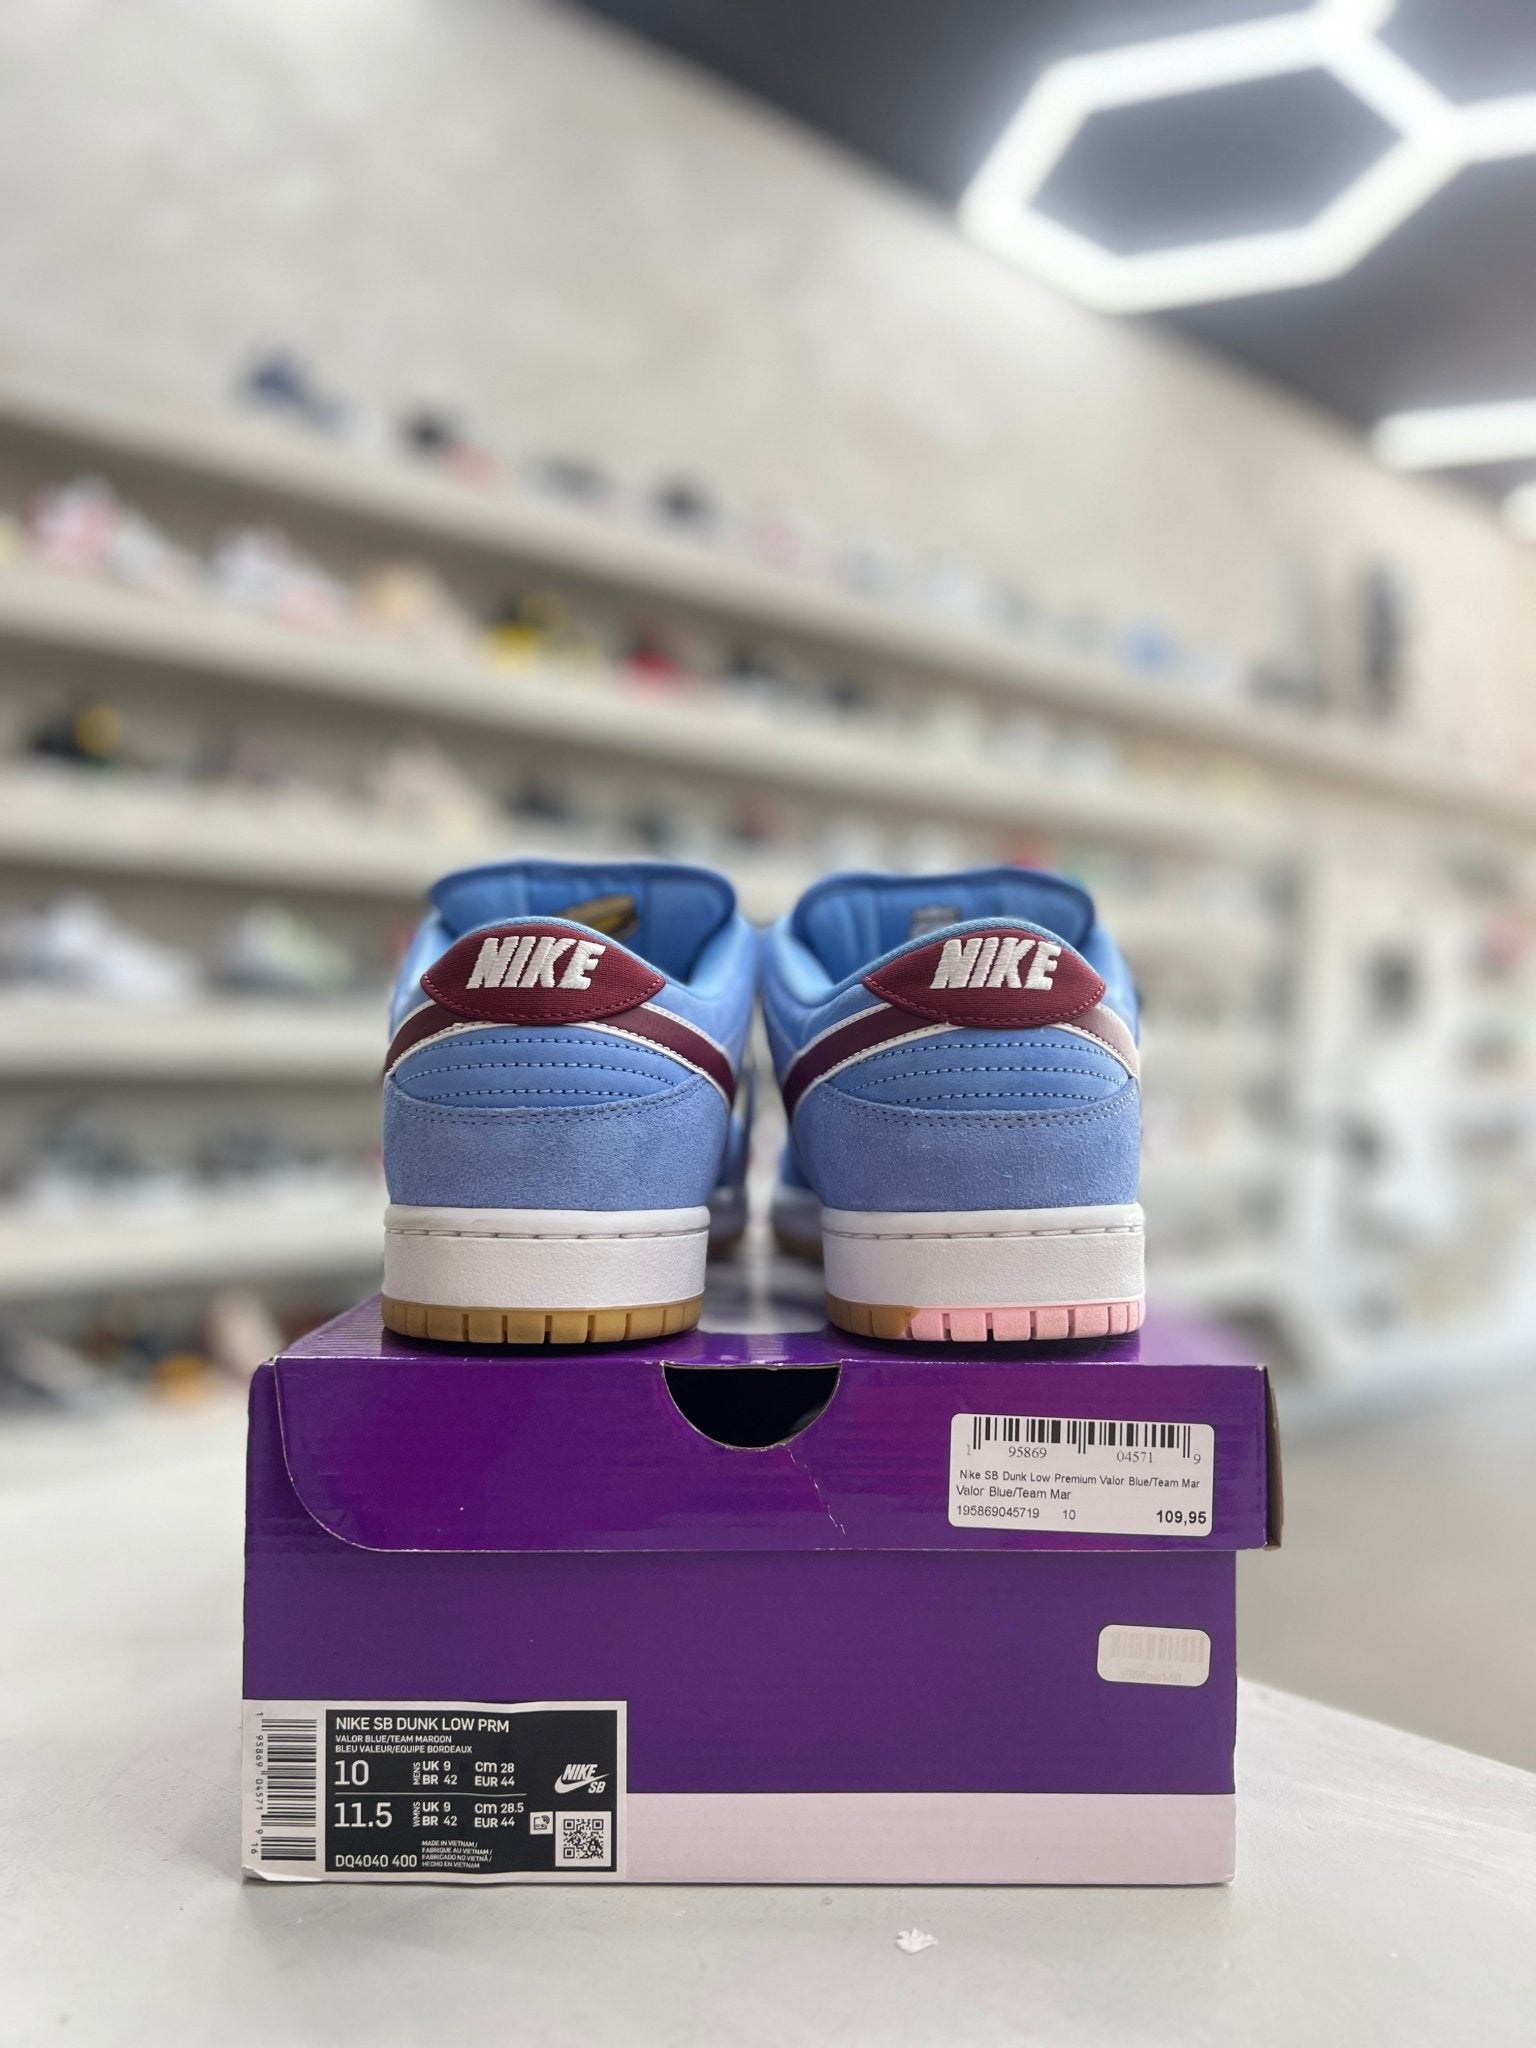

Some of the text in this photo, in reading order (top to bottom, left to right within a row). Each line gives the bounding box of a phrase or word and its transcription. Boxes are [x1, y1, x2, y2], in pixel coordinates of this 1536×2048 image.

[466, 936, 606, 990] NIKE
[930, 937, 1061, 990] NIKE
[966, 1444, 1201, 1464] 1 95869 04571 9
[959, 1469, 1200, 1488] Nke SB Dunk Low Premium Valor Blue/Team Mar
[956, 1484, 1071, 1500] Valor Blue/Team Mar
[957, 1504, 1076, 1520] 195869045719 10
[1156, 1509, 1207, 1526] 109,95
[336, 1717, 510, 1733] NIKE SB DUNK LOW PRM
[335, 1734, 452, 1744] VALOR BLUE/TEAM MAROON
[255, 1735, 263, 1767] 95869
[335, 1745, 358, 1753] BLEU
[427, 1745, 473, 1754] BORDEAUX
[334, 1760, 370, 1786] 10
[412, 1761, 421, 1785] MENS
[422, 1760, 451, 1771] UK 9
[500, 1762, 515, 1773] 28
[562, 1763, 598, 1780] NIKE
[422, 1774, 458, 1785] BR 42
[474, 1775, 515, 1787] EUR 44
[587, 1781, 607, 1794] SB
[255, 1778, 263, 1811] 04571
[334, 1801, 393, 1828] 11.5
[412, 1801, 421, 1828] WMNS
[422, 1801, 451, 1812] UK 9
[500, 1802, 525, 1814] 28.5
[422, 1815, 458, 1826] BR 42
[474, 1816, 515, 1828] EUR 44
[335, 1854, 418, 1868] DQ4040 400
